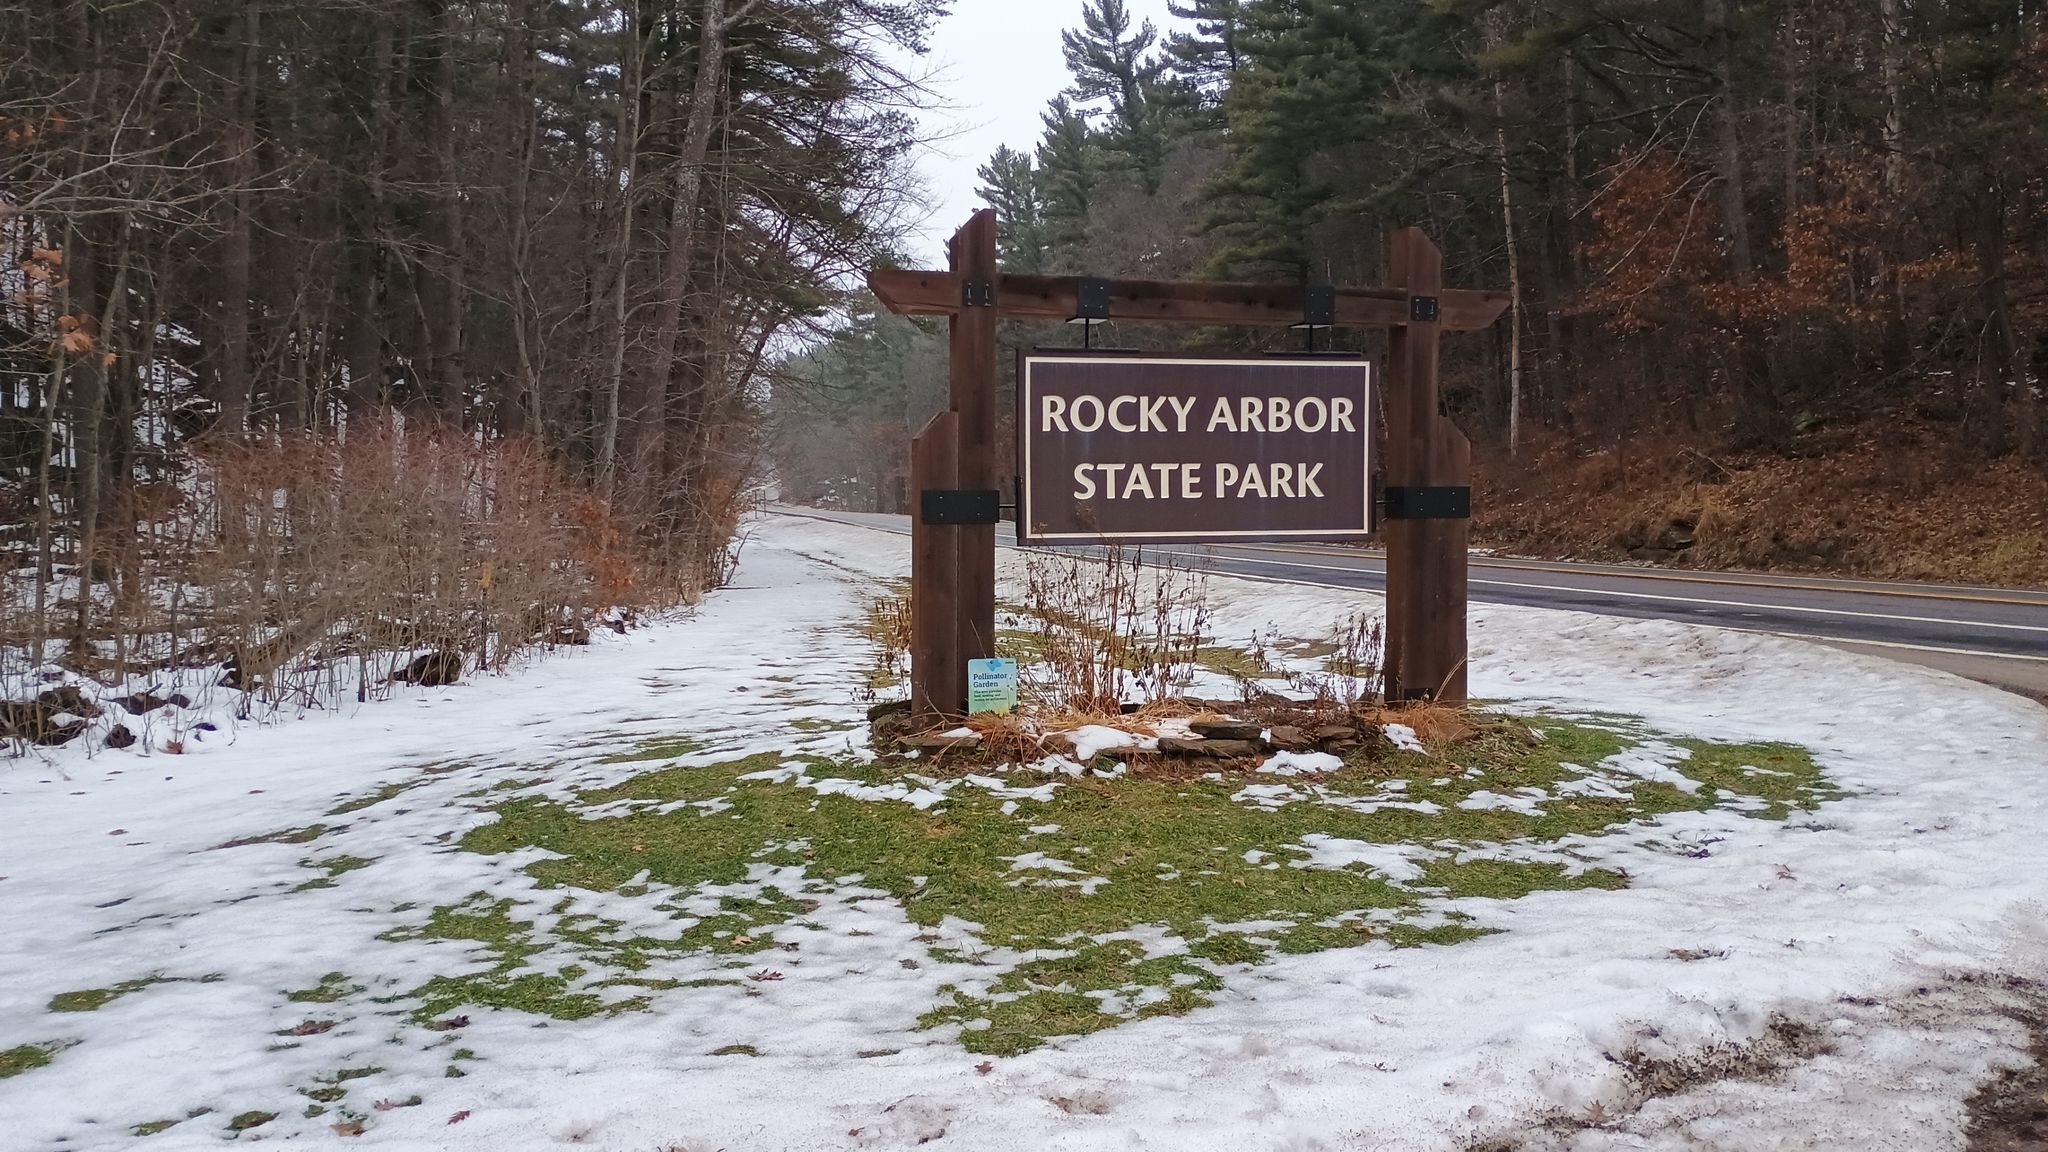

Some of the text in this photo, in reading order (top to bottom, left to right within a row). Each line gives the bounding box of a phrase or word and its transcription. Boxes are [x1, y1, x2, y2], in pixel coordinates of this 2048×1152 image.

[1042, 395, 1356, 433] ROCKY ARBOR
[1073, 462, 1325, 500] STATE PARK
